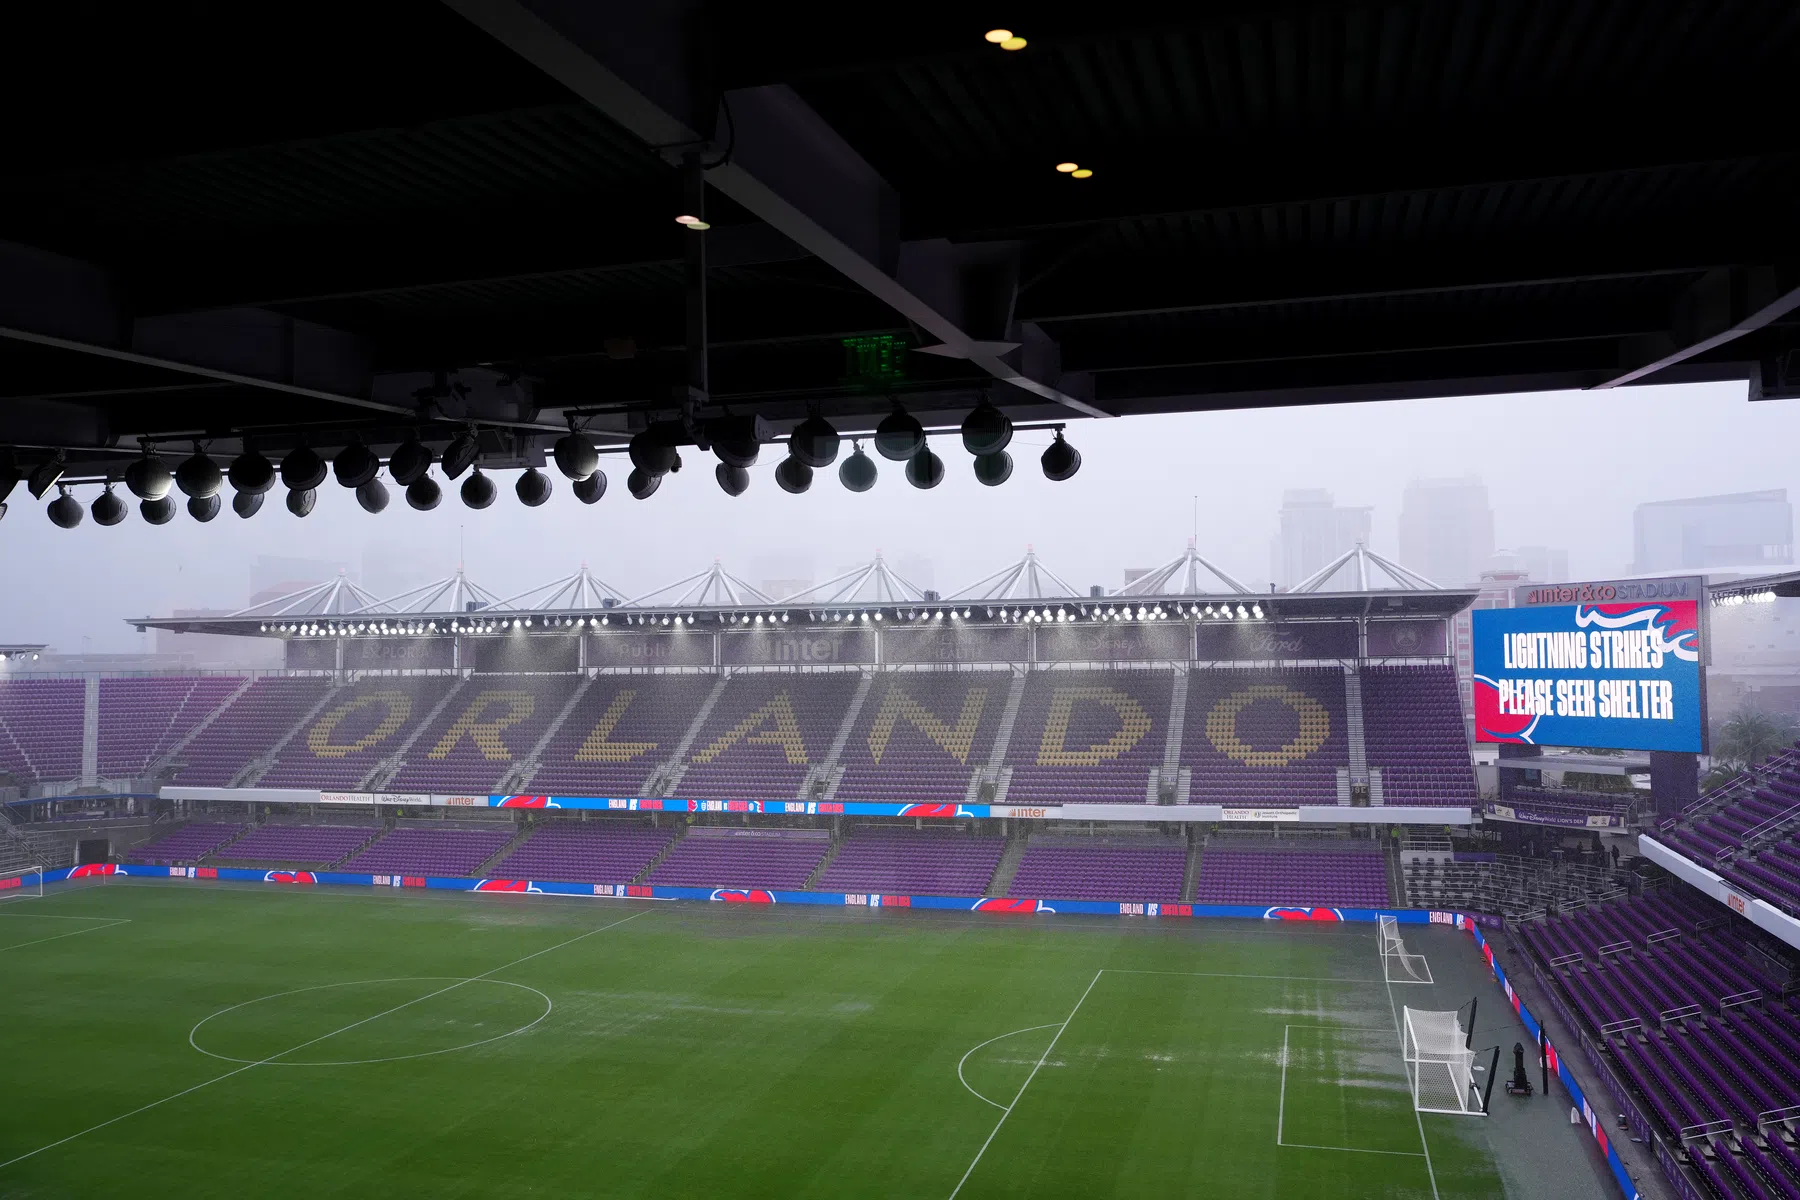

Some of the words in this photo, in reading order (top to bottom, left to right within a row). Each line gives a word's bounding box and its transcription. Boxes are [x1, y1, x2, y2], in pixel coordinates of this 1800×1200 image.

[1617, 582, 1689, 599] STADIUM
[1250, 632, 1304, 652] Ford
[1503, 631, 1588, 669] LIGHTNING
[1590, 630, 1664, 669] STRIKES
[1498, 679, 1554, 716] PLEASE
[1556, 679, 1596, 717] SEEK
[1598, 680, 1674, 719] SHELTER
[306, 686, 1331, 768] ORLANDO
[321, 794, 349, 802] ORLANDO
[593, 884, 614, 895] ENGLAND
[616, 884, 625, 897] VS
[845, 893, 867, 905] ENGLAND
[870, 894, 880, 907] VS
[1120, 903, 1144, 914] ENGLAND
[1148, 903, 1159, 916] VS
[1429, 911, 1453, 925] ENGLAND
